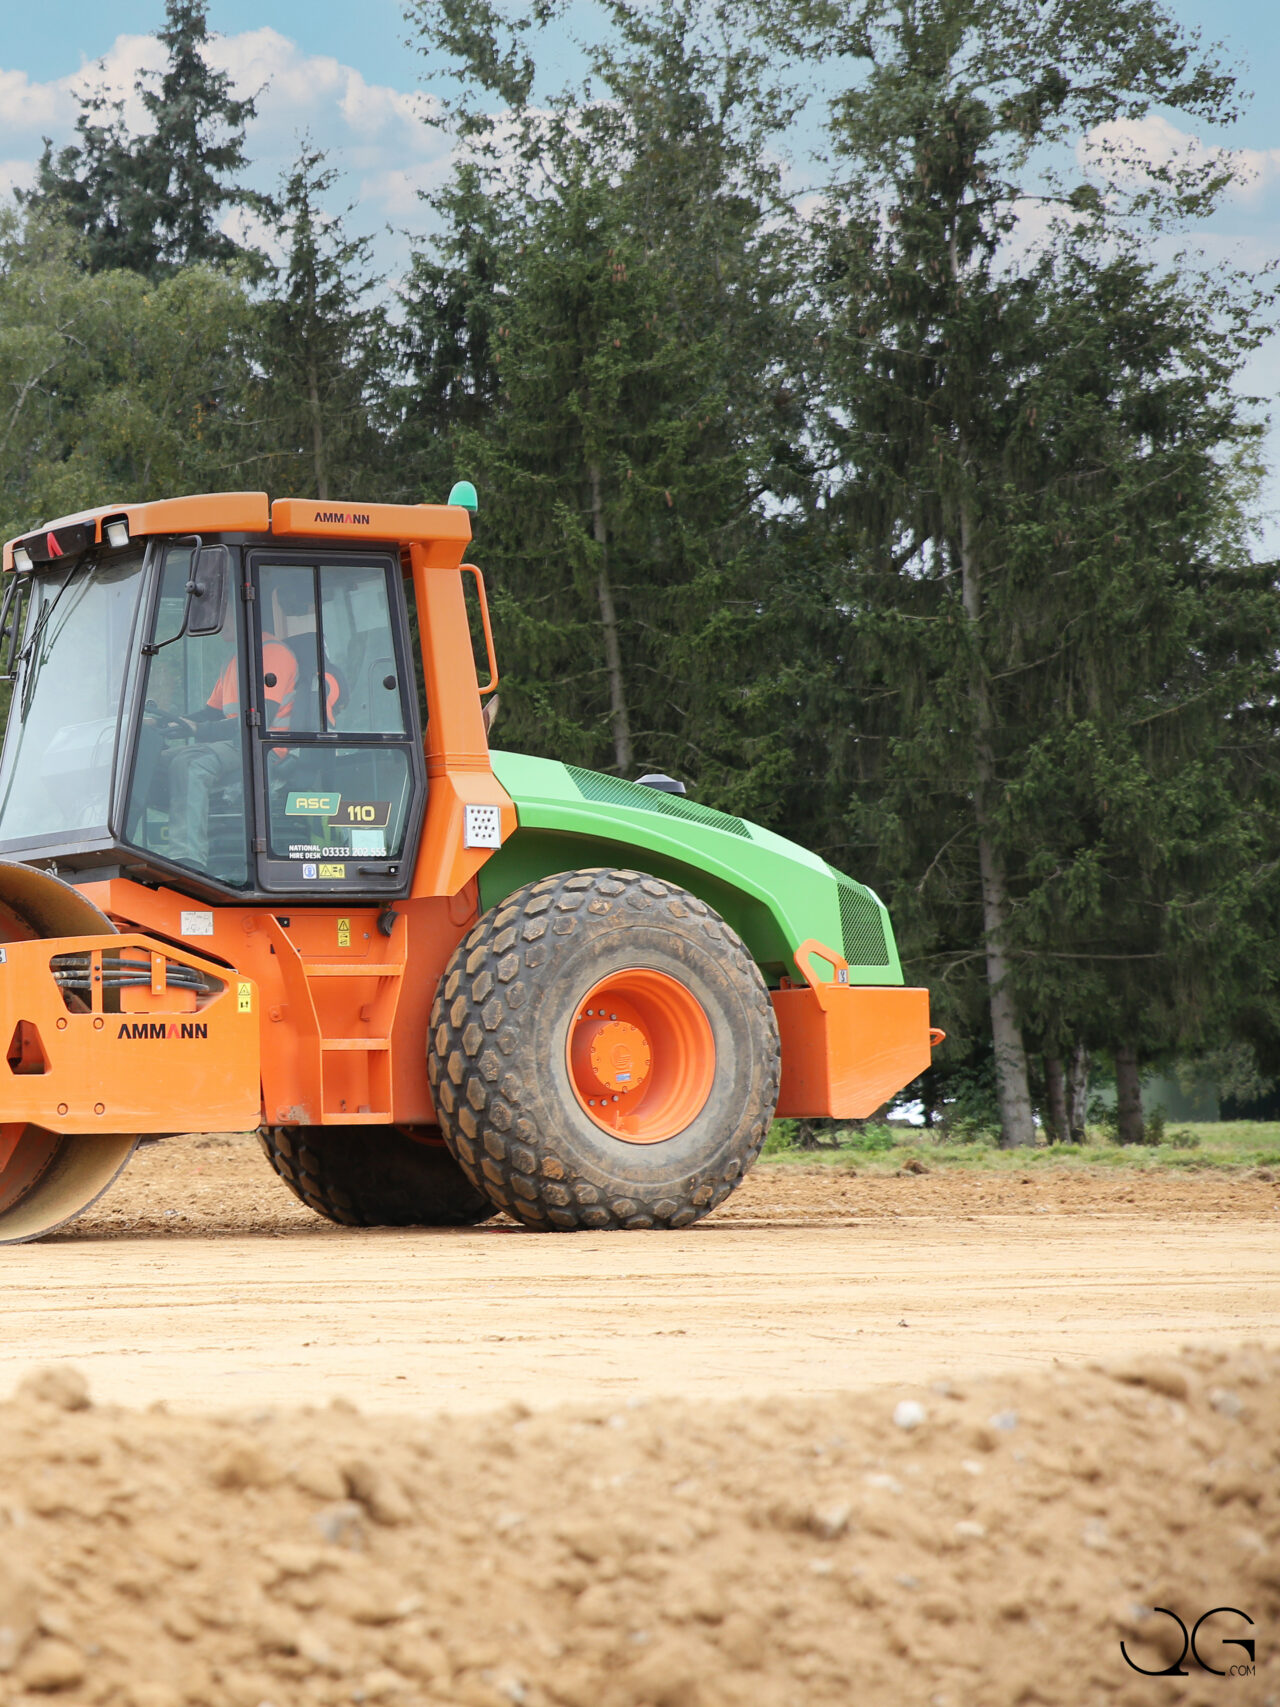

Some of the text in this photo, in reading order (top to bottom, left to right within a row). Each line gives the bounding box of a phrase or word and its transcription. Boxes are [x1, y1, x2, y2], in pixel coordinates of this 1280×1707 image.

[314, 512, 370, 525] AMMANN
[296, 798, 330, 809] ASC
[348, 805, 375, 821] 110
[322, 847, 387, 857] 03333 202 555
[117, 1023, 208, 1039] AMMANN
